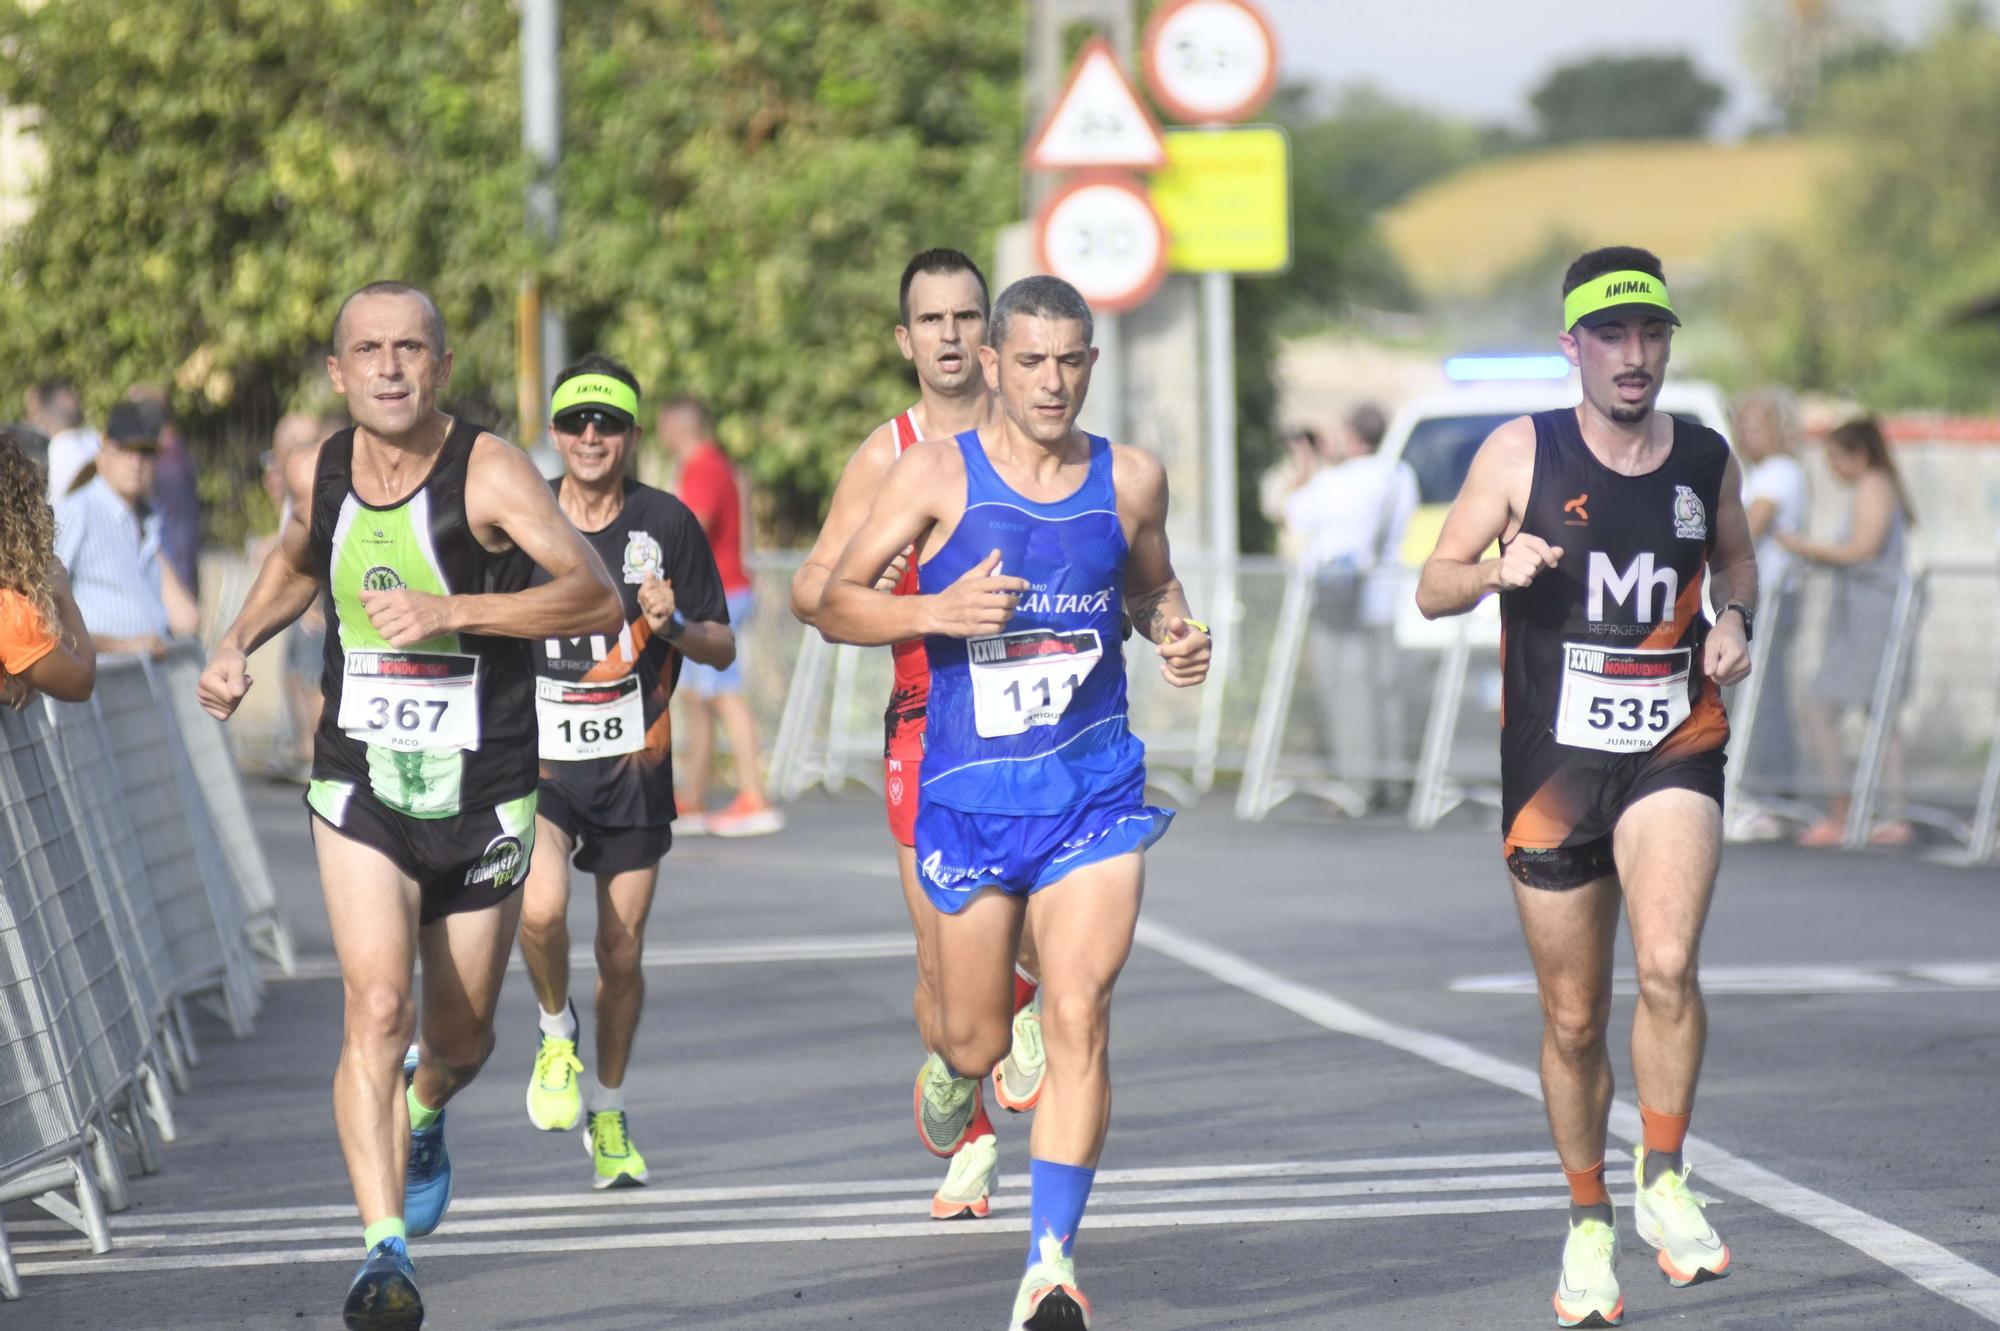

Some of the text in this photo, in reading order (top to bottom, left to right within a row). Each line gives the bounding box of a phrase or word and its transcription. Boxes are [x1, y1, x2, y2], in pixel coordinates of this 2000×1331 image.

[1605, 281, 1652, 298] ANIMAL
[1587, 551, 1679, 623] Mh
[973, 638, 1006, 663] XXVIII
[1570, 650, 1605, 674] XXVIII
[348, 653, 379, 674] XXVIII
[367, 697, 449, 733] 367
[1588, 696, 1670, 732] 535
[391, 737, 419, 747] PACO
[557, 717, 623, 743] 168
[1605, 738, 1654, 747] JUANFRA
